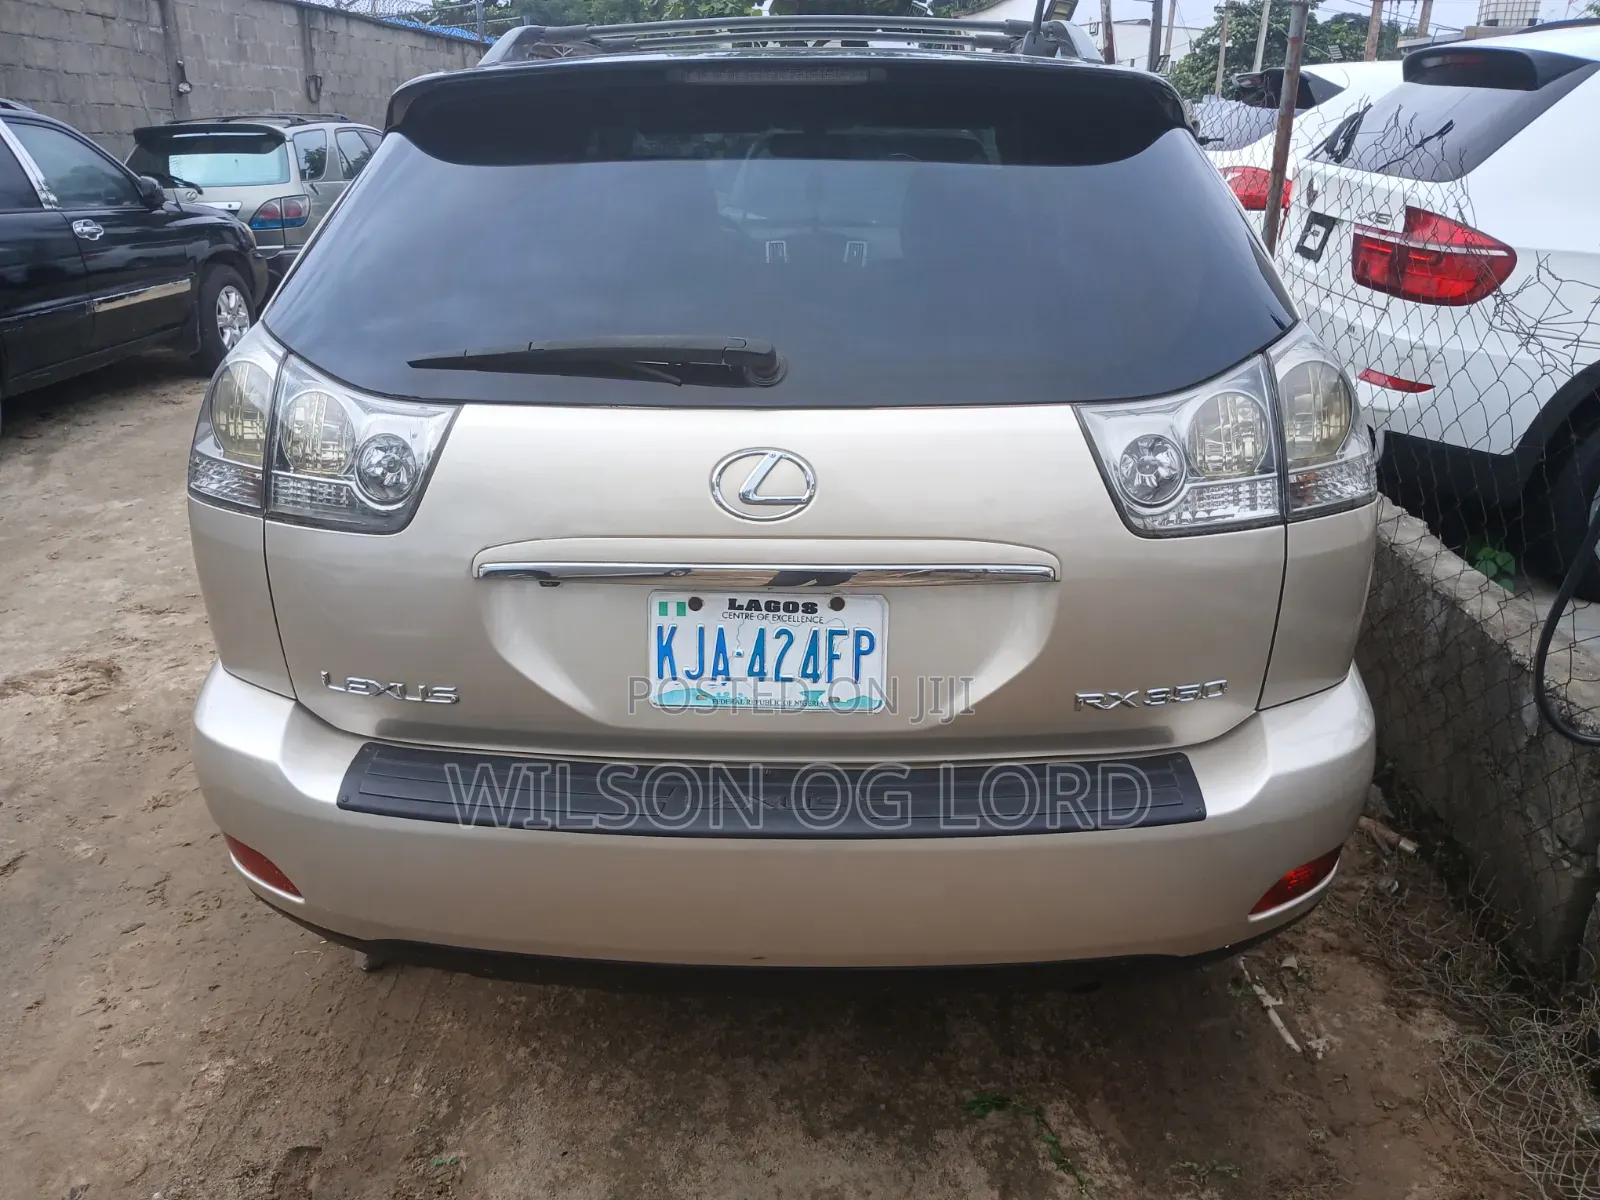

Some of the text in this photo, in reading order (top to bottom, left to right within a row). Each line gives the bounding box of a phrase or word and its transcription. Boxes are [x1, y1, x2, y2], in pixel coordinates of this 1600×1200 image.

[721, 611, 824, 625] CENTRE OF EXCELLENCE
[727, 598, 819, 615] LAGOS
[320, 670, 460, 704] LEXUS
[1074, 679, 1228, 711] RX 350
